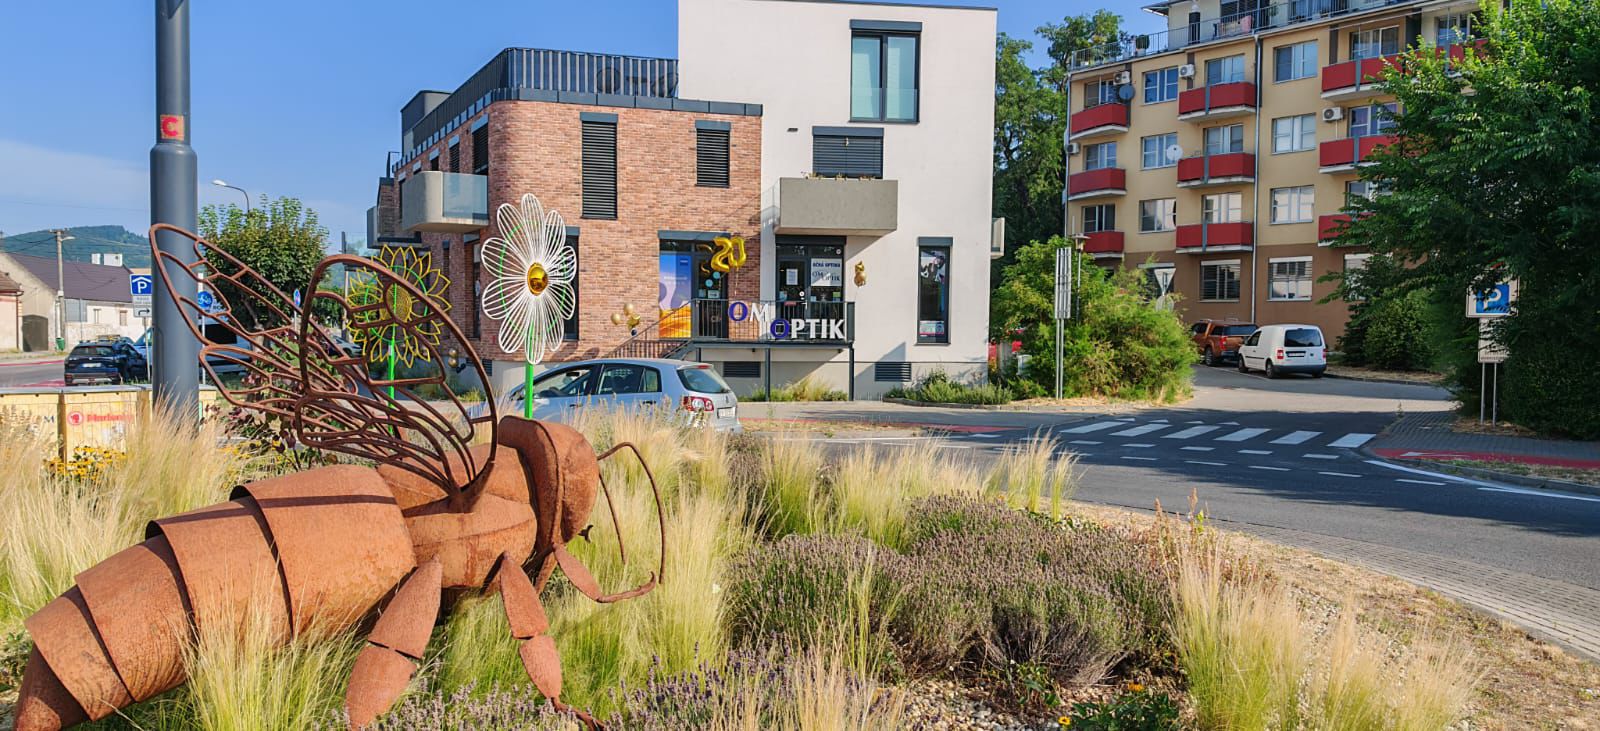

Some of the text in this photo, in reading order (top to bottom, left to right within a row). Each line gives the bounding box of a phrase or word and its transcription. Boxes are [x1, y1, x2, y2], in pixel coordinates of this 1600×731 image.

[711, 236, 747, 272] 20
[137, 281, 147, 294] P
[728, 301, 770, 322] OM
[770, 318, 845, 339] OPTIK
